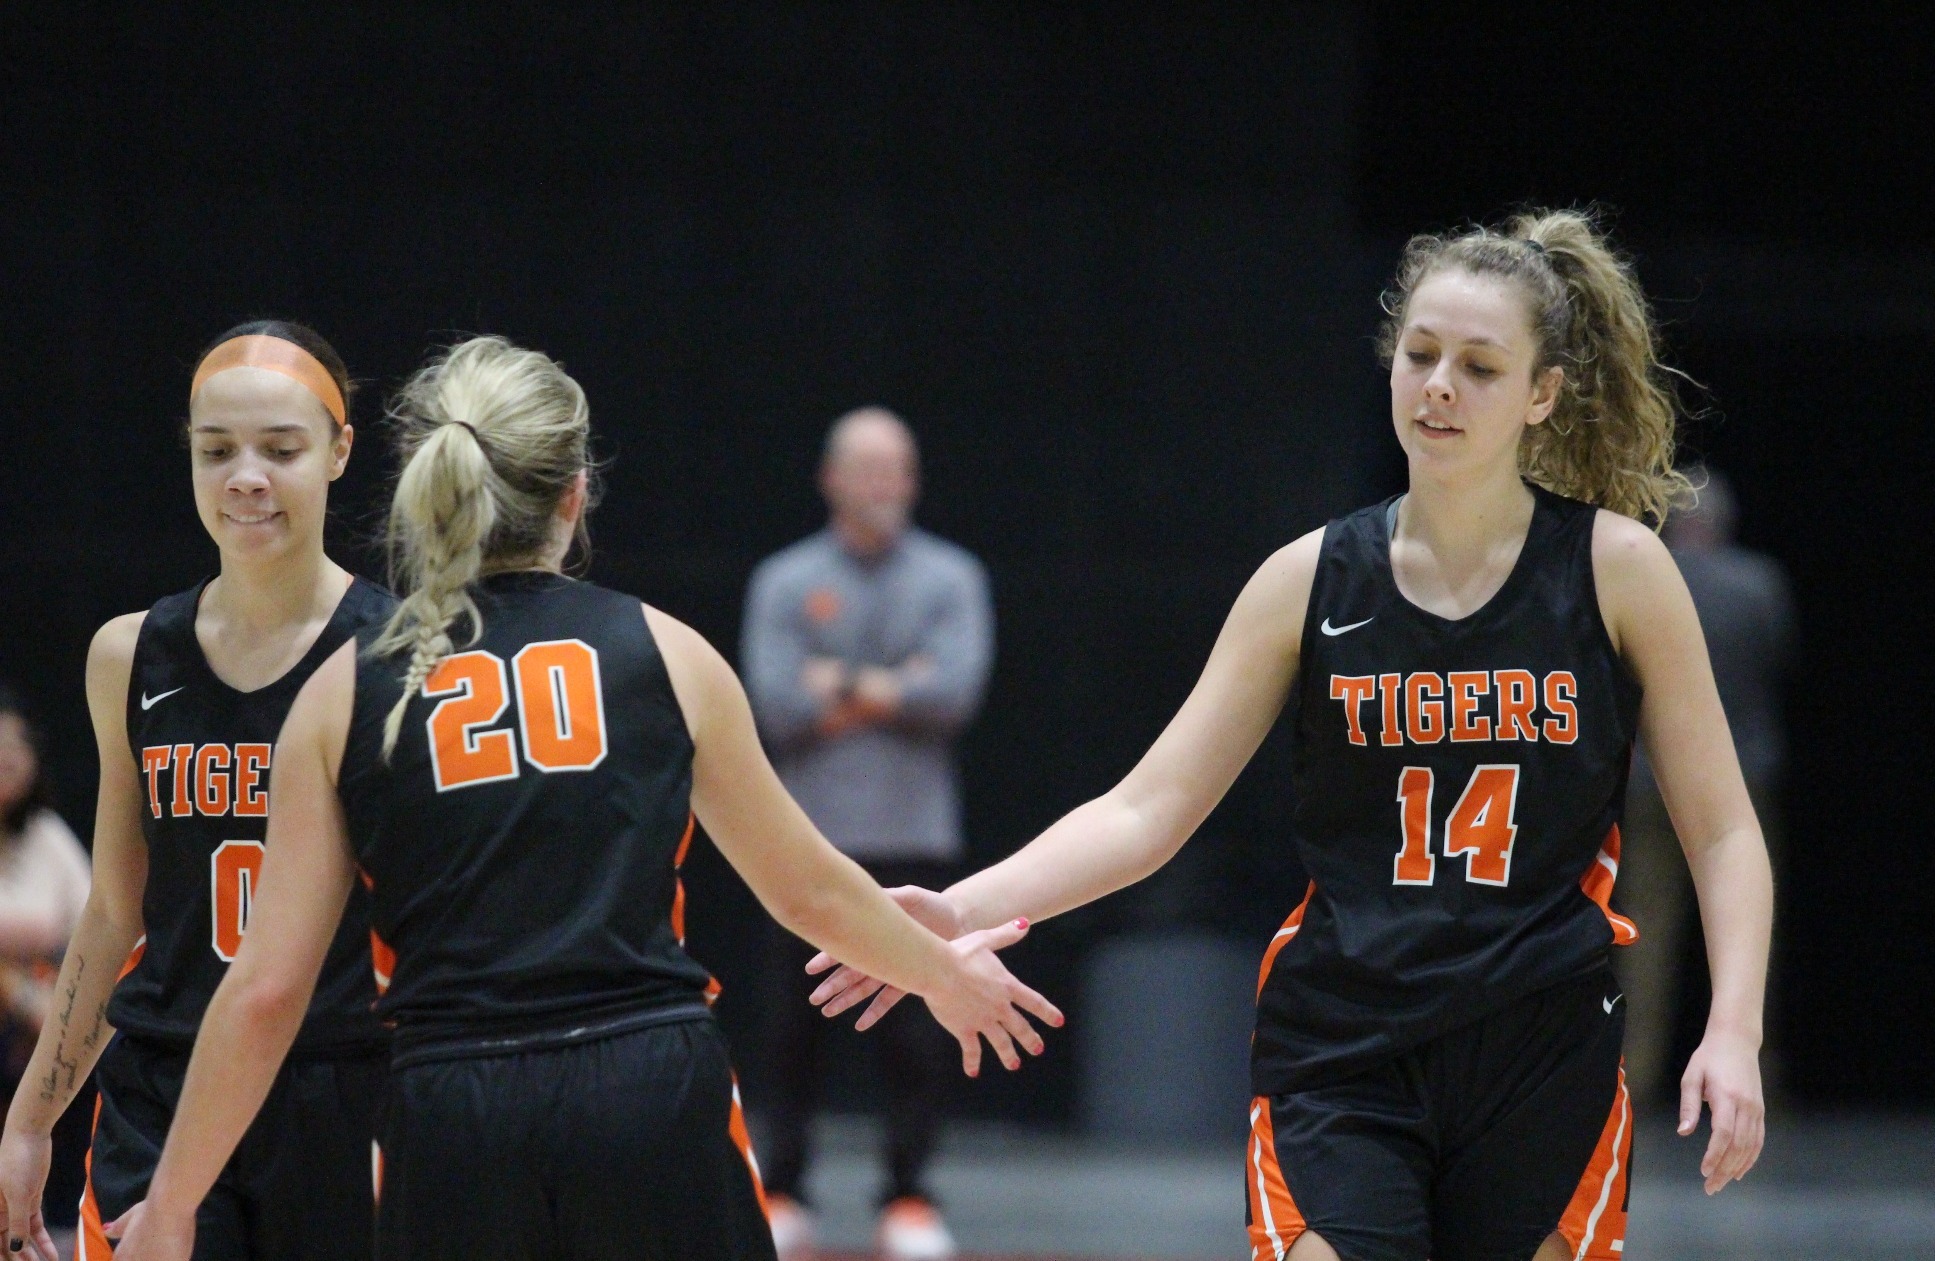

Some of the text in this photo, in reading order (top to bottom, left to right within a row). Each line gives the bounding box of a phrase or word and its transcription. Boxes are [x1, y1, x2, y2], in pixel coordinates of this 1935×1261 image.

[421, 638, 608, 793] 20
[1329, 669, 1579, 747] TIGERS
[142, 742, 272, 819] TIGE
[1392, 764, 1520, 887] 14
[211, 839, 266, 963] 0
